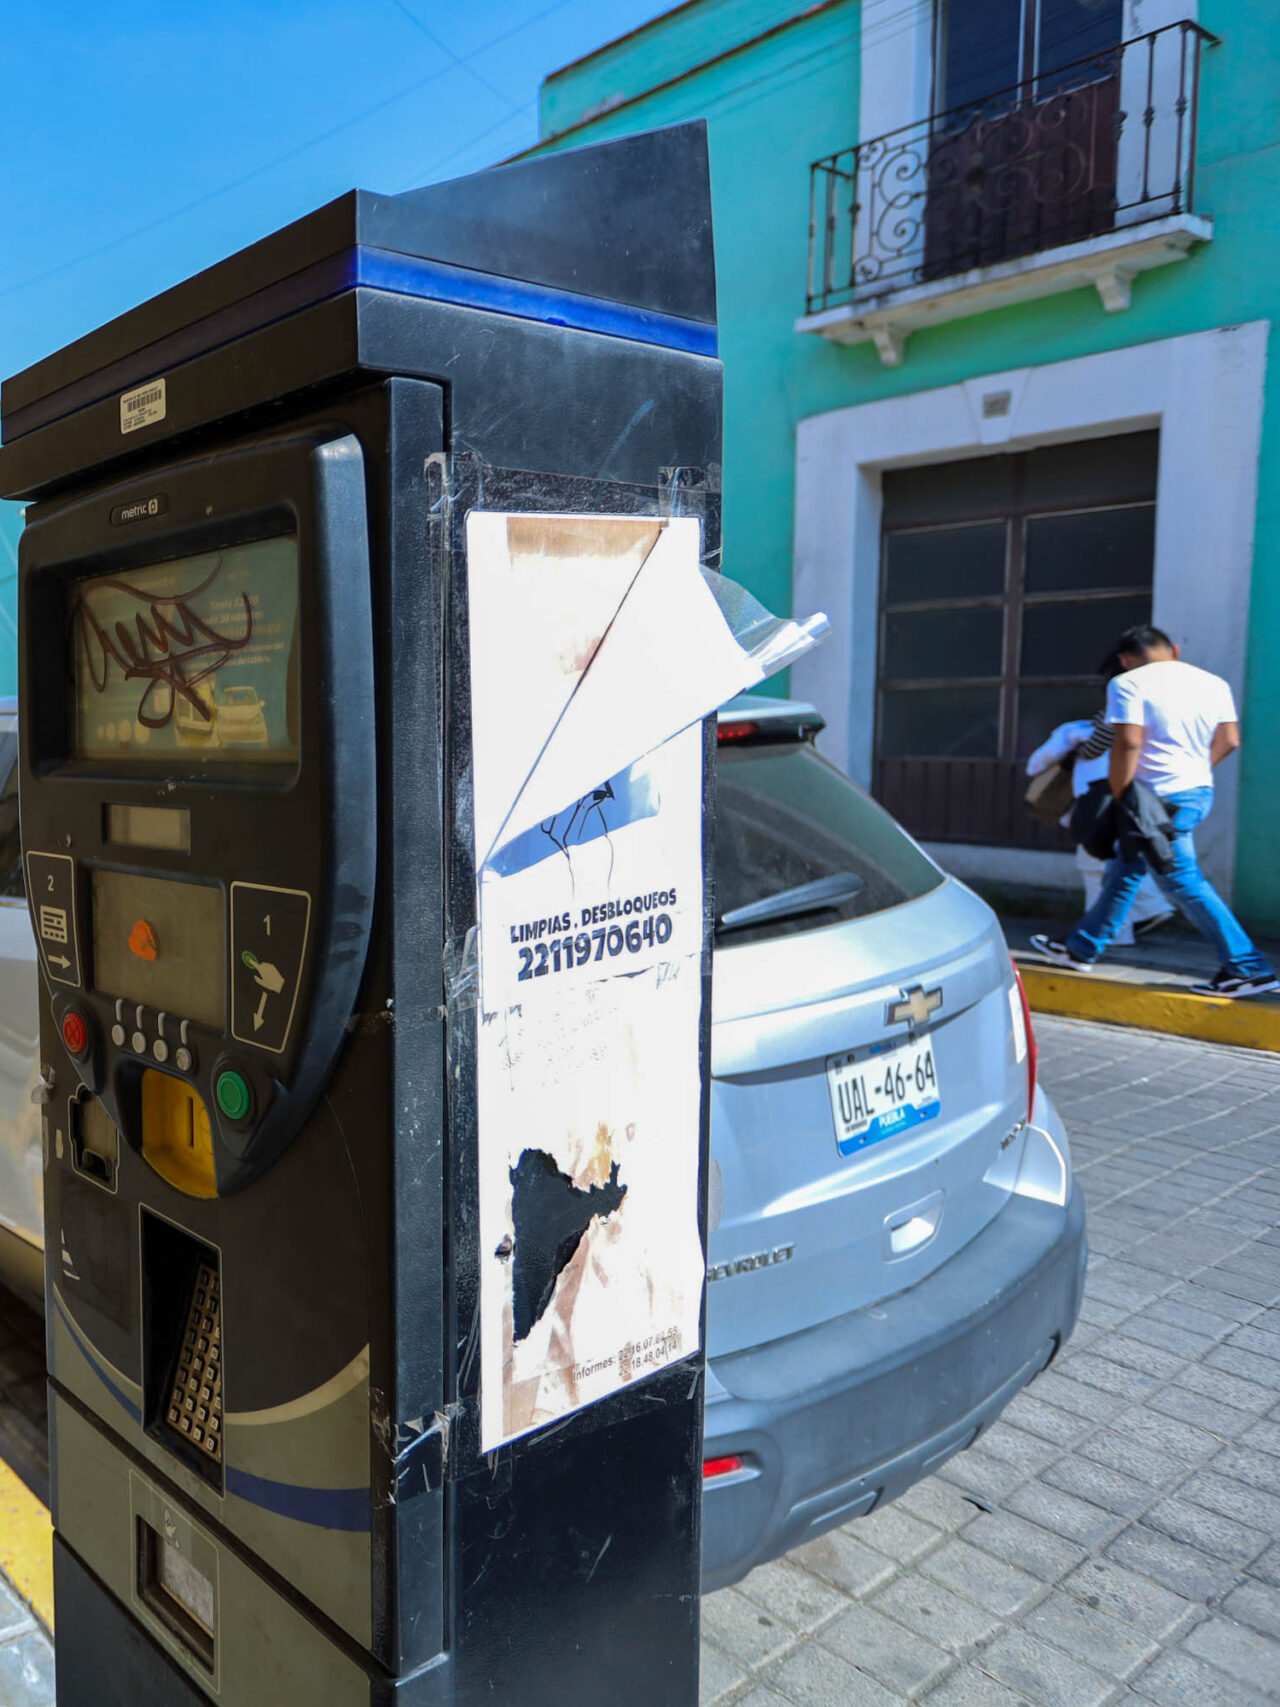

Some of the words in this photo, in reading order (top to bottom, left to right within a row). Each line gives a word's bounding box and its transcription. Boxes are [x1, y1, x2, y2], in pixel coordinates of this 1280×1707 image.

[121, 503, 148, 520] metric
[47, 874, 55, 892] 2
[581, 888, 677, 926] DESBLOQUEOS
[263, 914, 271, 936] 1
[518, 913, 673, 982] 2211970640
[878, 1106, 906, 1128] PUEBLA
[707, 1242, 797, 1283] EVROLET
[573, 1354, 617, 1382] Informes:
